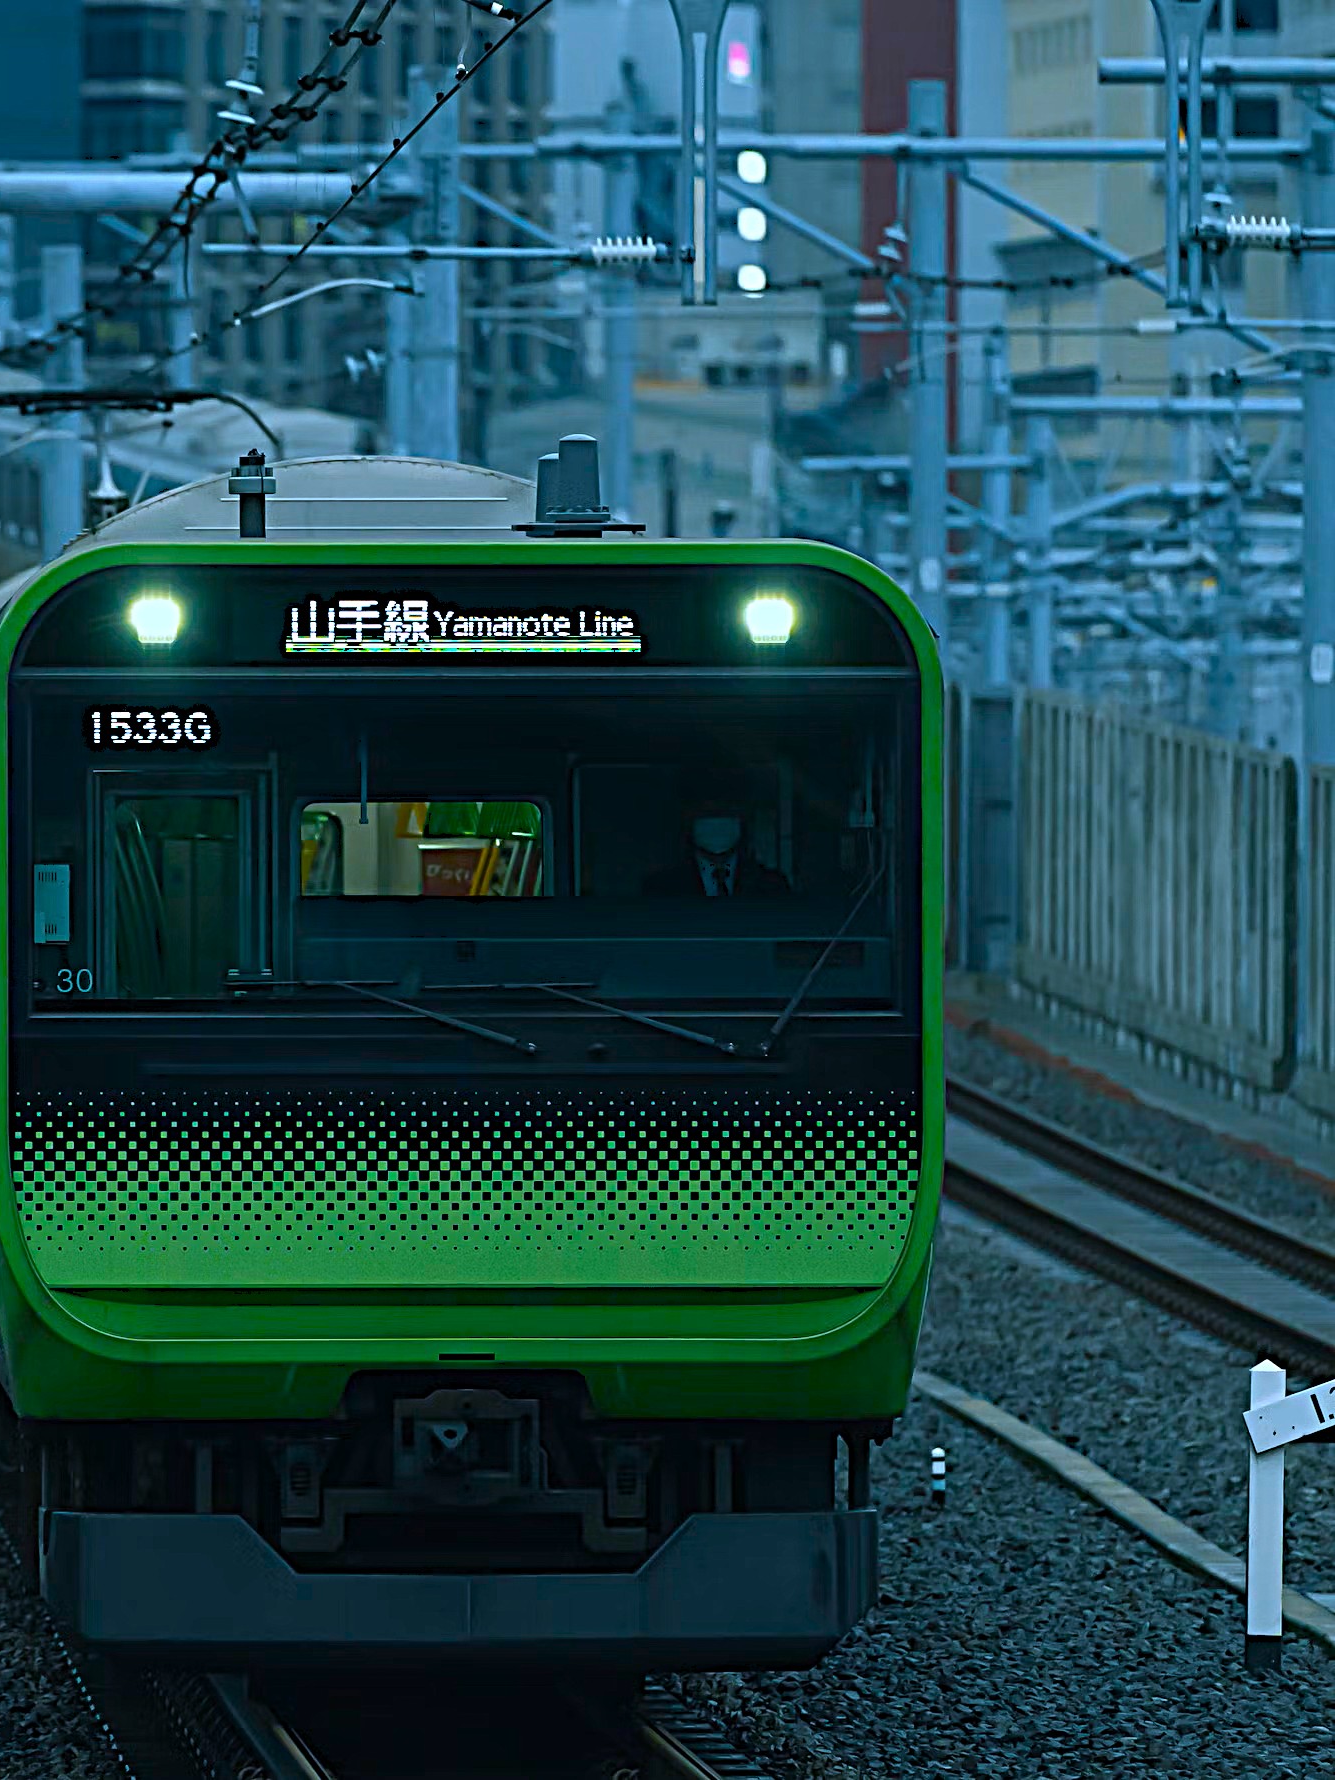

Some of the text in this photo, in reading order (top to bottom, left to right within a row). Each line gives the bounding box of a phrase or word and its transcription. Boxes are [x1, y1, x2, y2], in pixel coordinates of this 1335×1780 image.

[291, 600, 634, 643] 山手線 Yamanote Line
[91, 711, 211, 744] 1533G
[56, 968, 93, 993] 30
